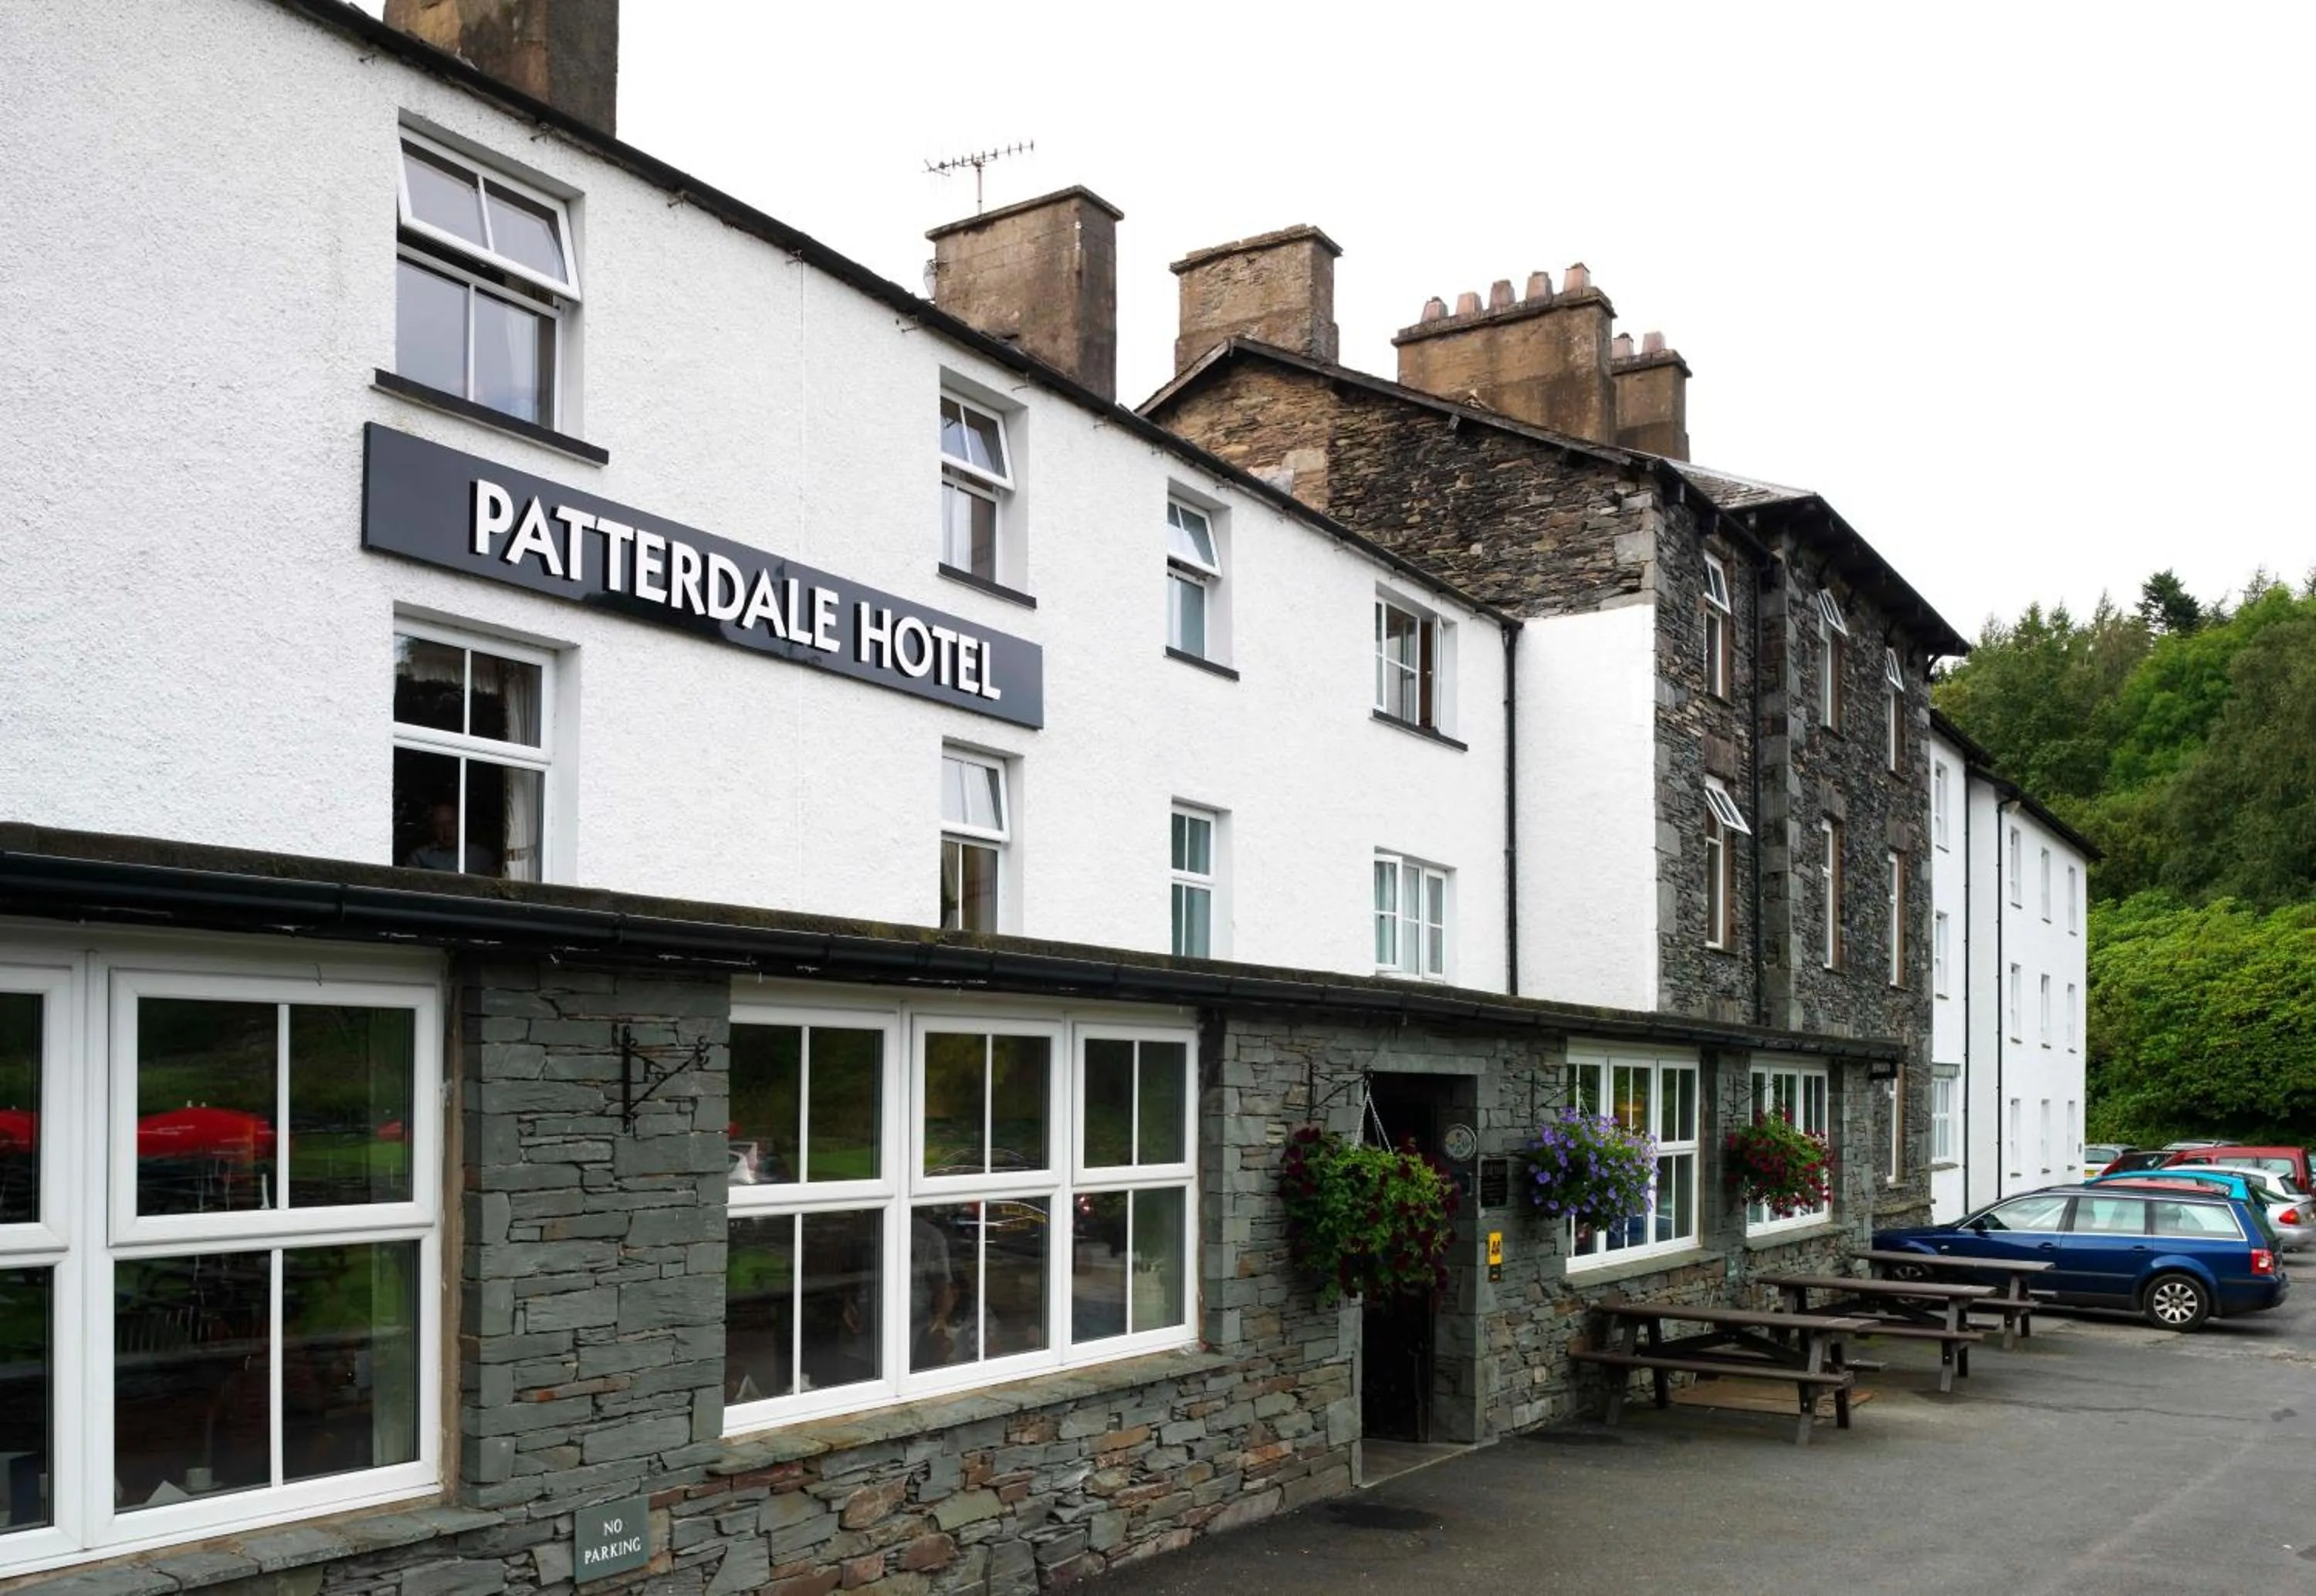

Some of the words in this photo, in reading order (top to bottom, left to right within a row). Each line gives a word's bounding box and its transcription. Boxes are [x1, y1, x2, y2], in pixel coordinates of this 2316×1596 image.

[476, 478, 841, 654] PATTERDALE
[860, 601, 1001, 701] HOTEL
[603, 1518, 623, 1537] NO
[584, 1536, 642, 1564] PARKING
